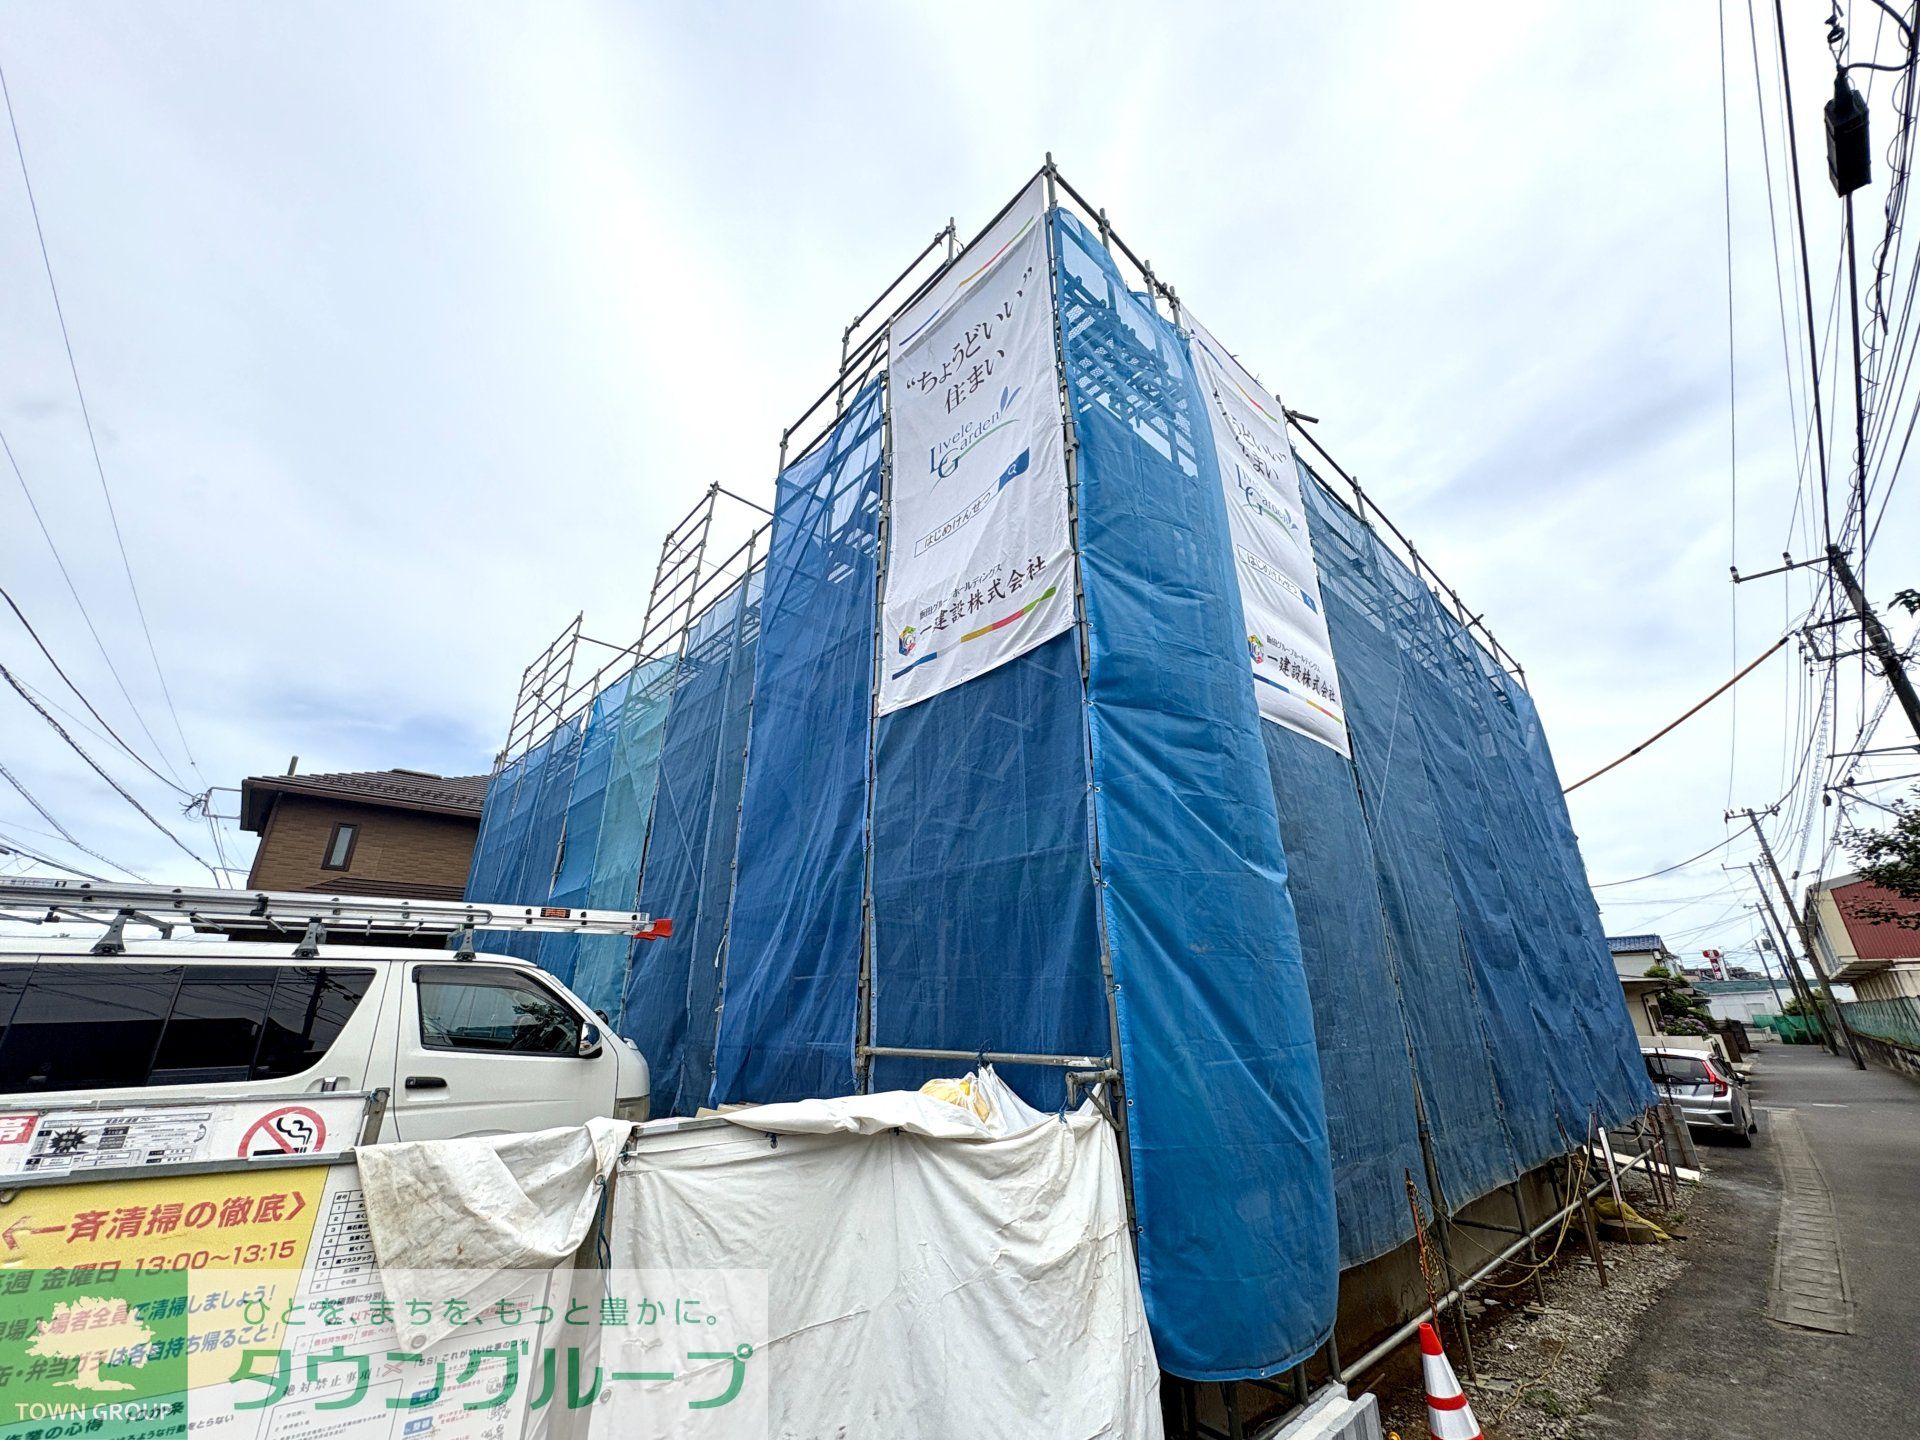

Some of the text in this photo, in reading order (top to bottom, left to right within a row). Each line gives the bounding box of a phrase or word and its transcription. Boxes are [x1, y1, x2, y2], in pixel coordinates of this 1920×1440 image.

[944, 349, 1005, 414] 住まい
[930, 421, 973, 474] Livele
[938, 411, 1001, 478] Garden
[924, 491, 992, 548] はじめけんせつ
[919, 556, 1047, 635] 一建設株式会社
[1266, 654, 1336, 702] 一建設株式会社
[40, 1259, 122, 1292] 金曜日
